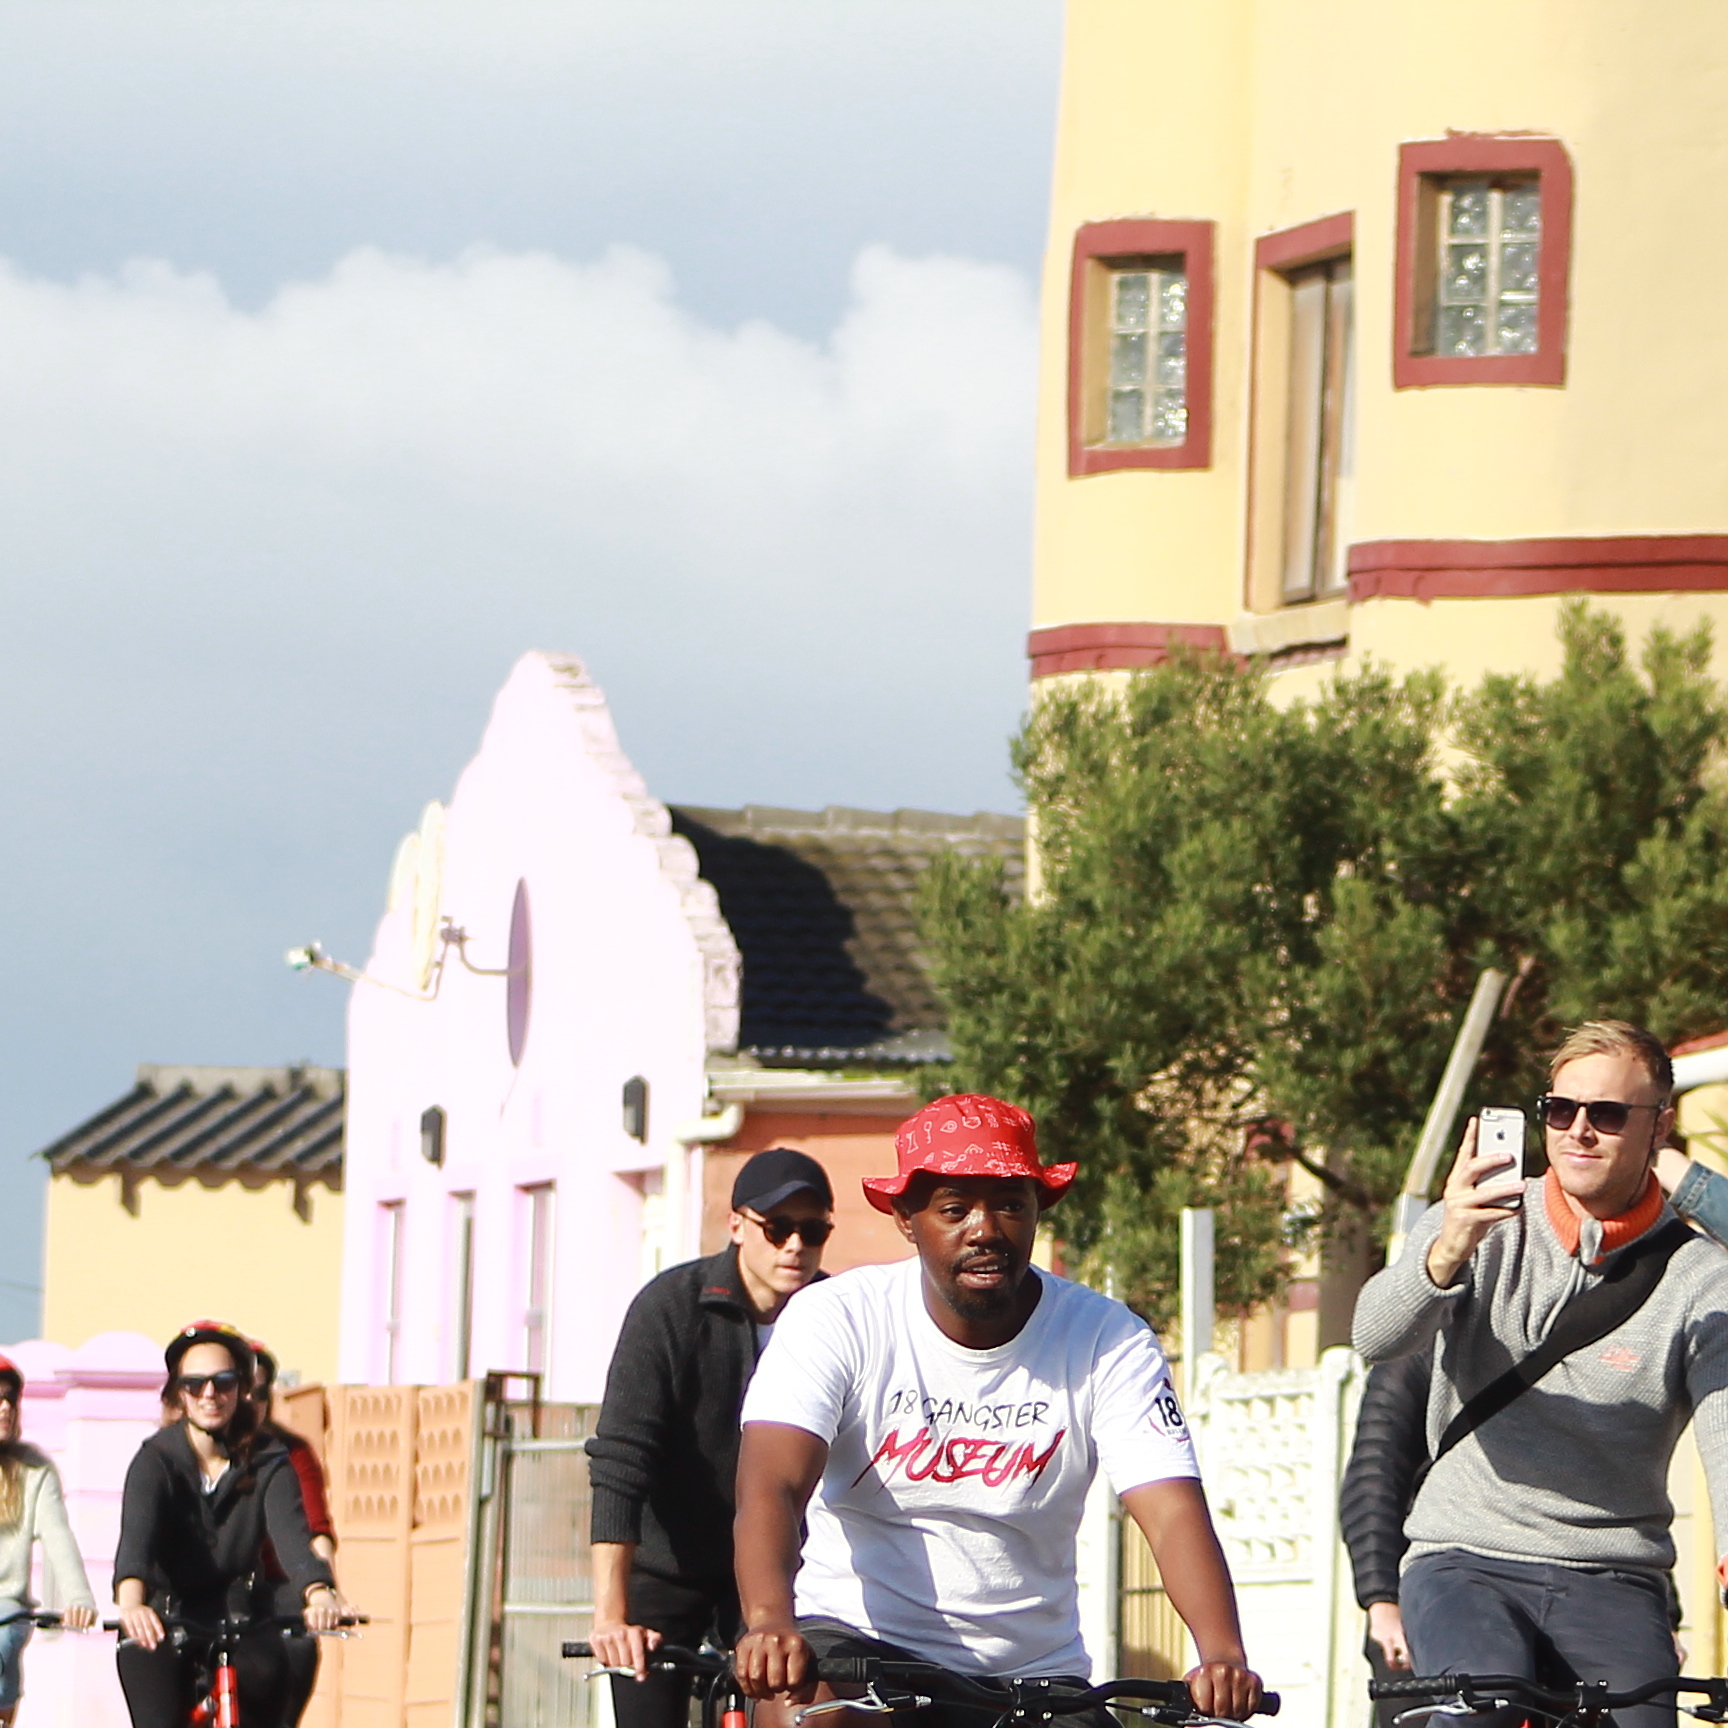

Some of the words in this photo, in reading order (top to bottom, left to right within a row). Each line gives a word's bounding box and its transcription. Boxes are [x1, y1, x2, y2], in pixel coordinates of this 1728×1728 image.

[890, 1389, 919, 1415] 18
[922, 1397, 1051, 1431] GANGSTER
[1154, 1396, 1183, 1428] 18
[851, 1426, 1068, 1496] MUSEUM
